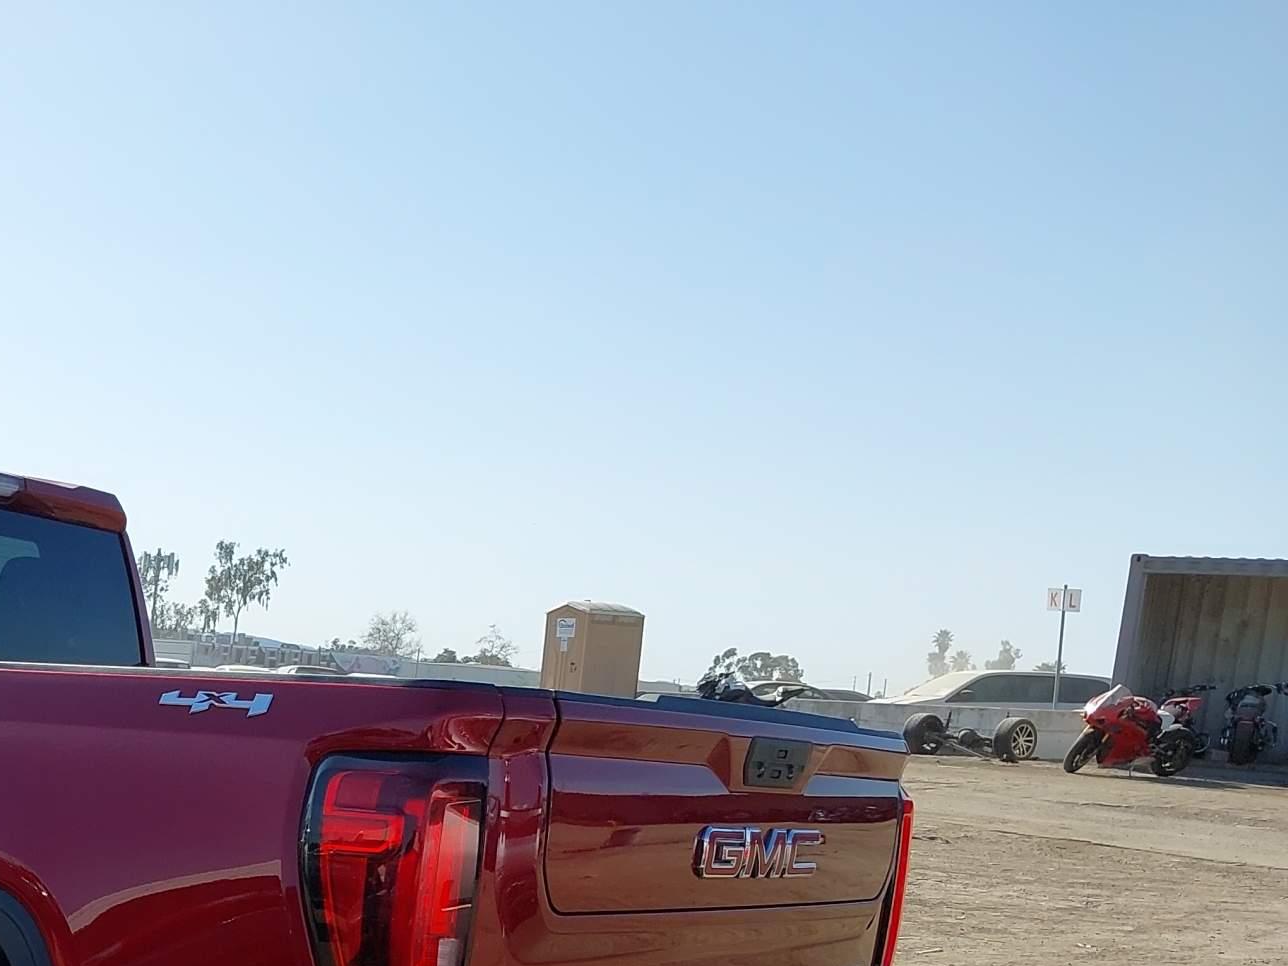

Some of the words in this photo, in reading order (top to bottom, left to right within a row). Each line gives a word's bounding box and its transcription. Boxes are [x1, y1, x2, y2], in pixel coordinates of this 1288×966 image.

[1050, 591, 1058, 607] K
[1069, 593, 1077, 608] L
[694, 826, 824, 879] GMC
